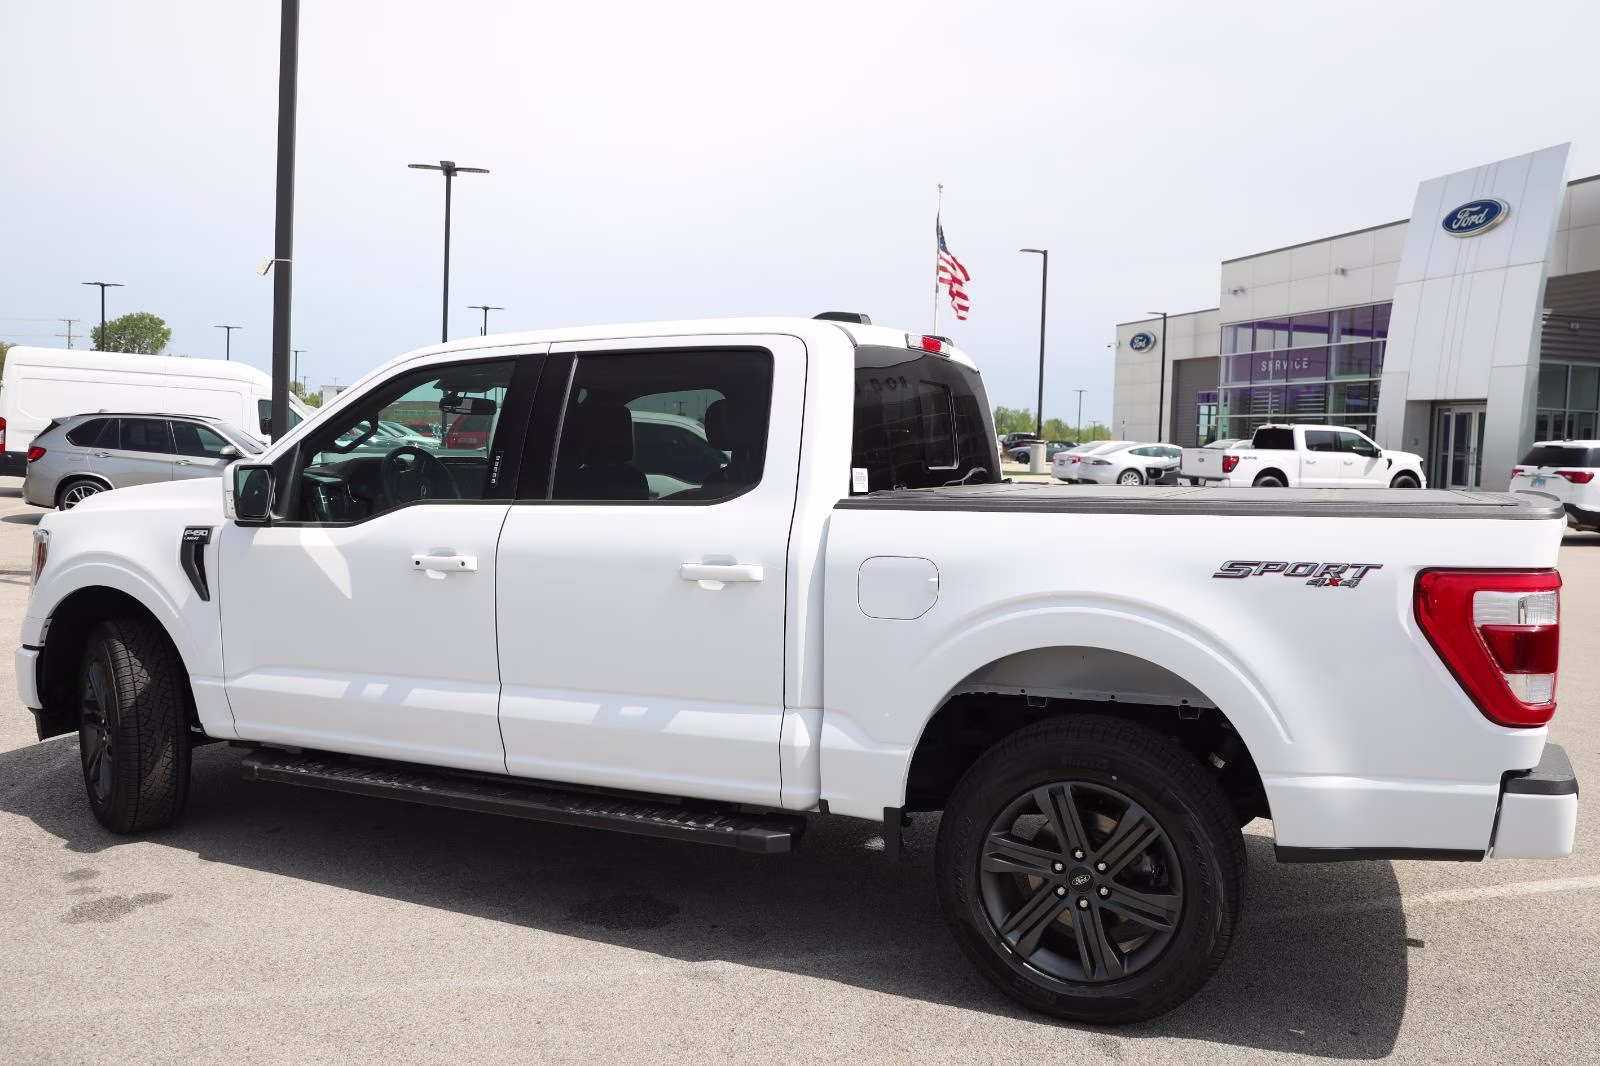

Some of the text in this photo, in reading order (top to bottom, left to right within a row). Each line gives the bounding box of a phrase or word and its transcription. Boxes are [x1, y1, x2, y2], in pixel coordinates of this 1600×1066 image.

[1451, 206, 1490, 229] Ford
[1260, 357, 1309, 372] SERVICE
[1212, 560, 1384, 579] SPORT
